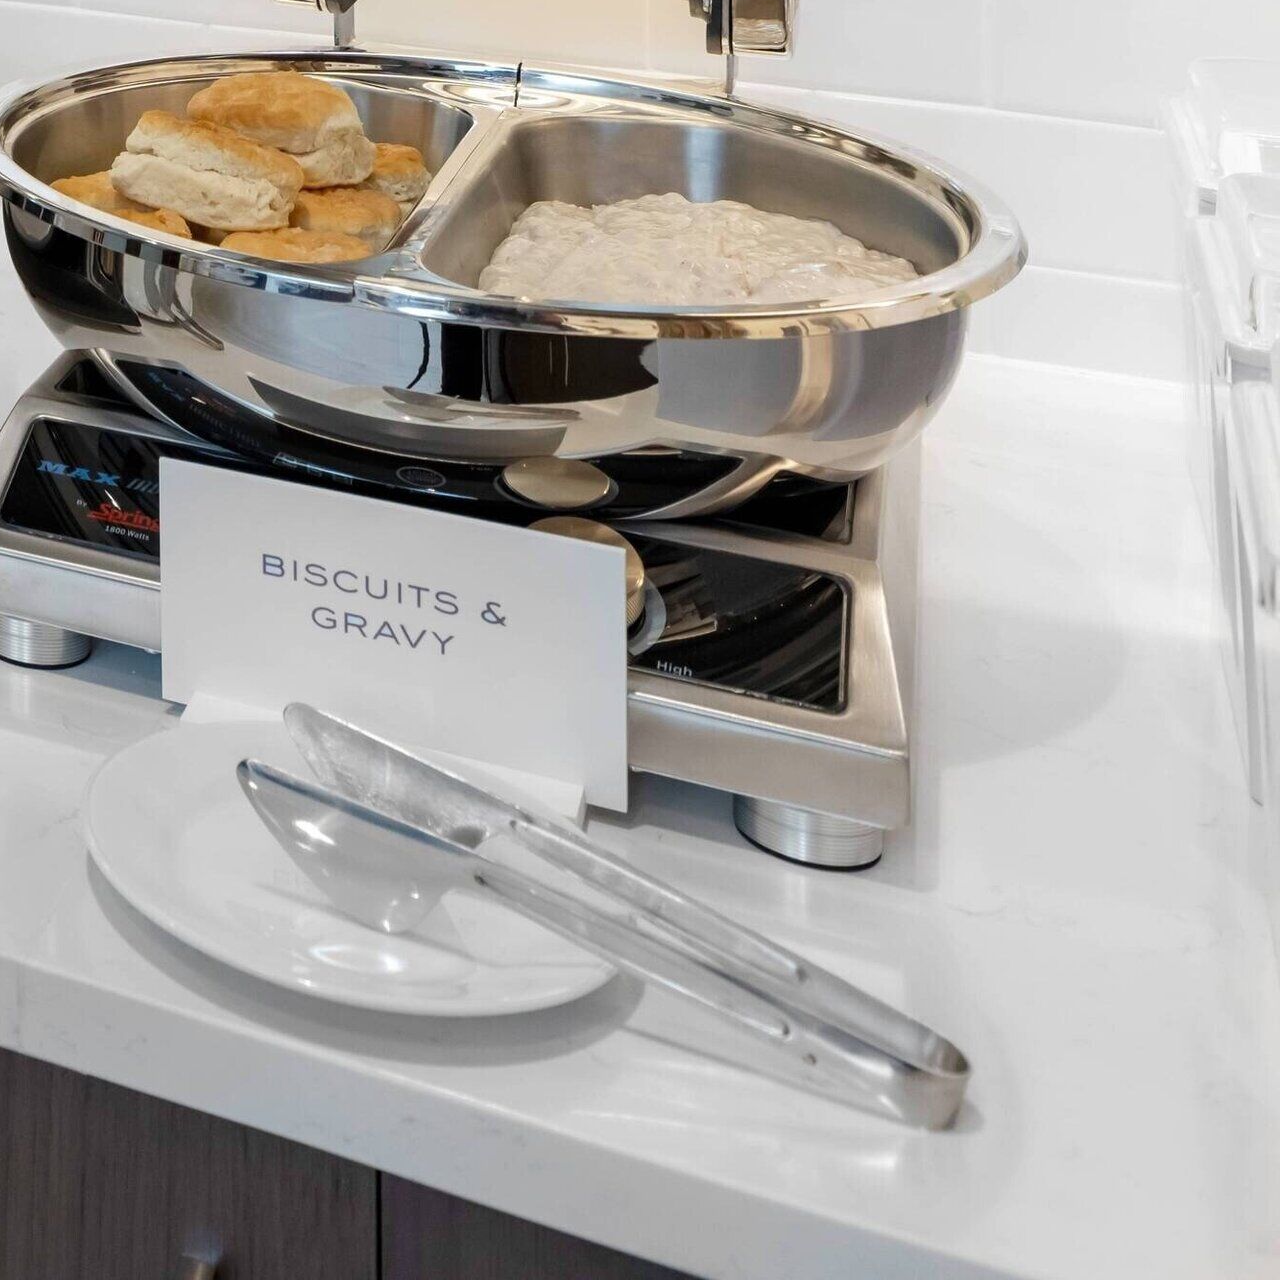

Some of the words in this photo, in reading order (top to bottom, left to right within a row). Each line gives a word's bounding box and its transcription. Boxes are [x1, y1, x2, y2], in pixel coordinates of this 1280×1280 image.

[37, 460, 120, 487] MAX
[105, 524, 125, 535] 1800
[127, 528, 149, 541] Watts
[262, 553, 460, 616] BISCUITS
[481, 602, 507, 628] &
[311, 607, 456, 656] GRAVY
[657, 660, 692, 677] High
